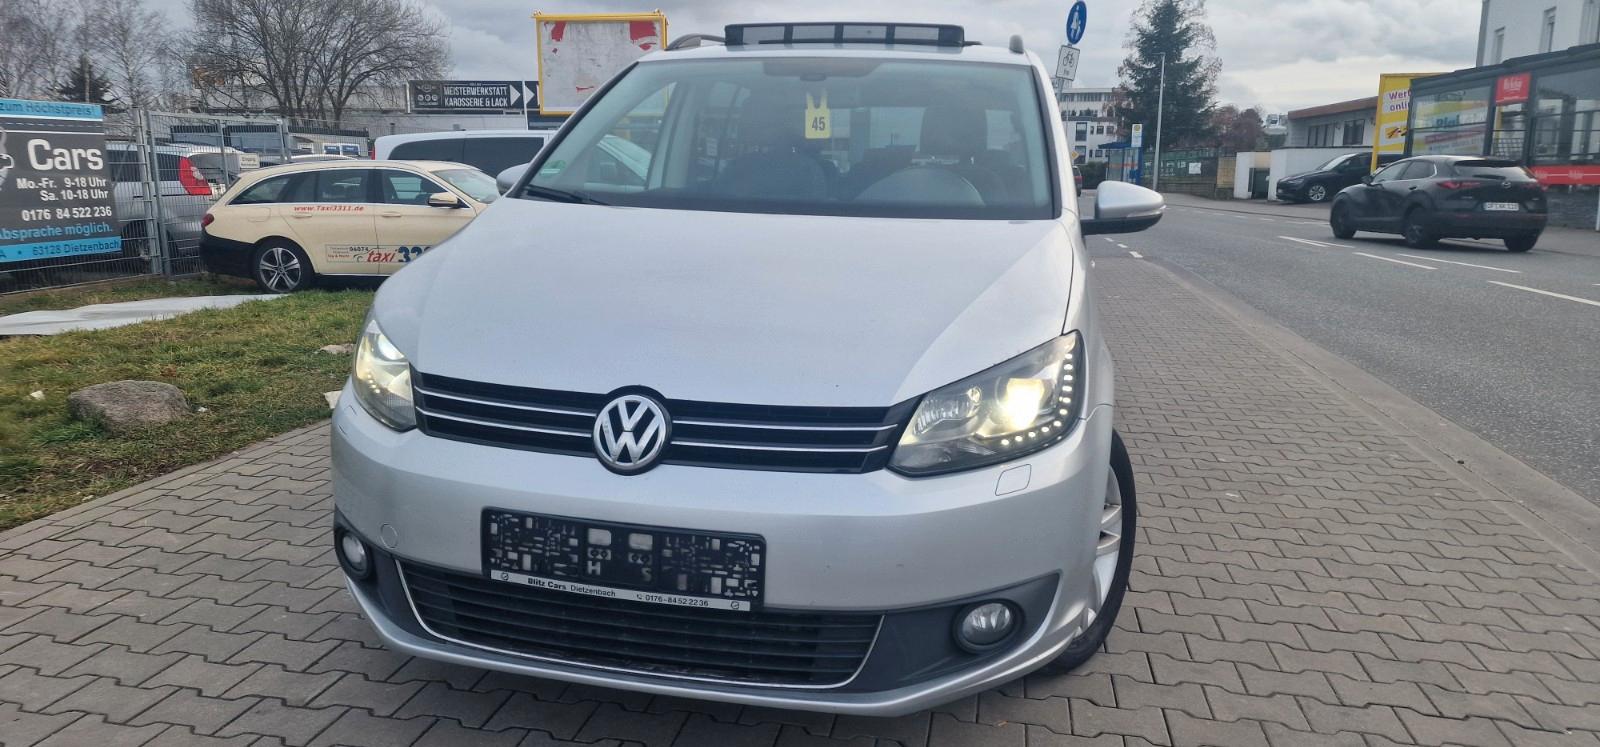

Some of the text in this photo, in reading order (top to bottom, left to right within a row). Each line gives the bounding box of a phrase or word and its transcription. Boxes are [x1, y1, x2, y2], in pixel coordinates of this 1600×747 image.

[443, 86, 508, 96] MEISTERWERKSTATT
[0, 103, 22, 112] zum
[444, 97, 508, 108] KAROSSERIE & LACK
[811, 116, 826, 131] 45
[27, 138, 104, 172] Cars
[16, 176, 107, 190] Mo.-Fr. 9-18 Uhr
[40, 188, 109, 201] Sa. 10-18 Uhr
[21, 206, 112, 221] 0176 84 522 236
[64, 222, 113, 237] möglich.
[32, 245, 61, 256] 63128
[63, 240, 119, 253] Dietzenbach
[366, 250, 396, 263] taxi
[599, 396, 665, 465] VW
[527, 577, 616, 597] Blitz Cars Dietzenbach
